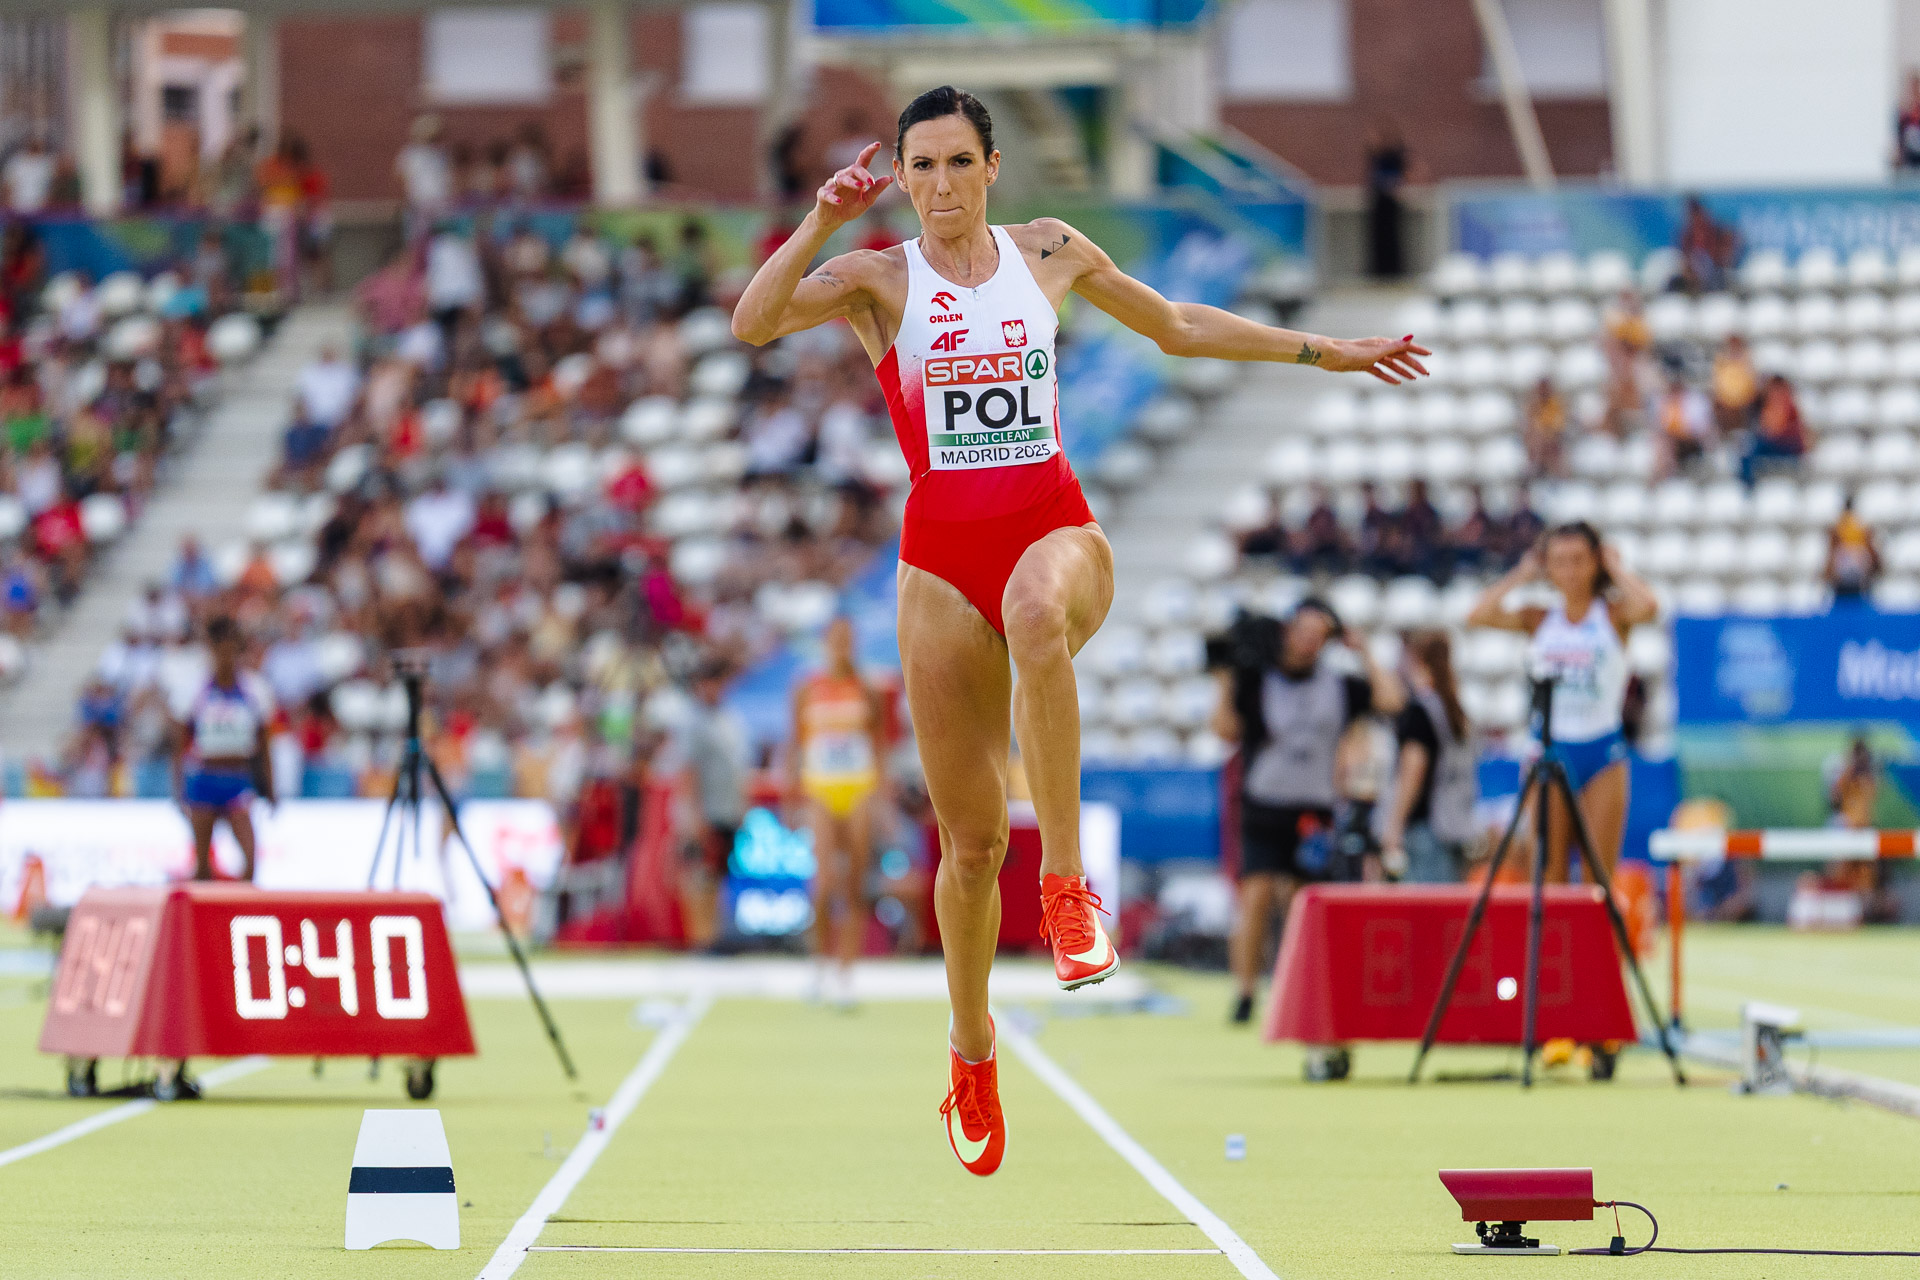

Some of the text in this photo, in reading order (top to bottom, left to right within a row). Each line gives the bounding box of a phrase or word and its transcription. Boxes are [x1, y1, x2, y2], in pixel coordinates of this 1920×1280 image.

[929, 313, 963, 324] ORLEN
[928, 357, 1020, 383] SPAR
[944, 386, 1041, 430] POL
[961, 432, 989, 444] RUN
[941, 443, 1051, 465] MADRID 2025
[231, 916, 428, 1019] 0:40
